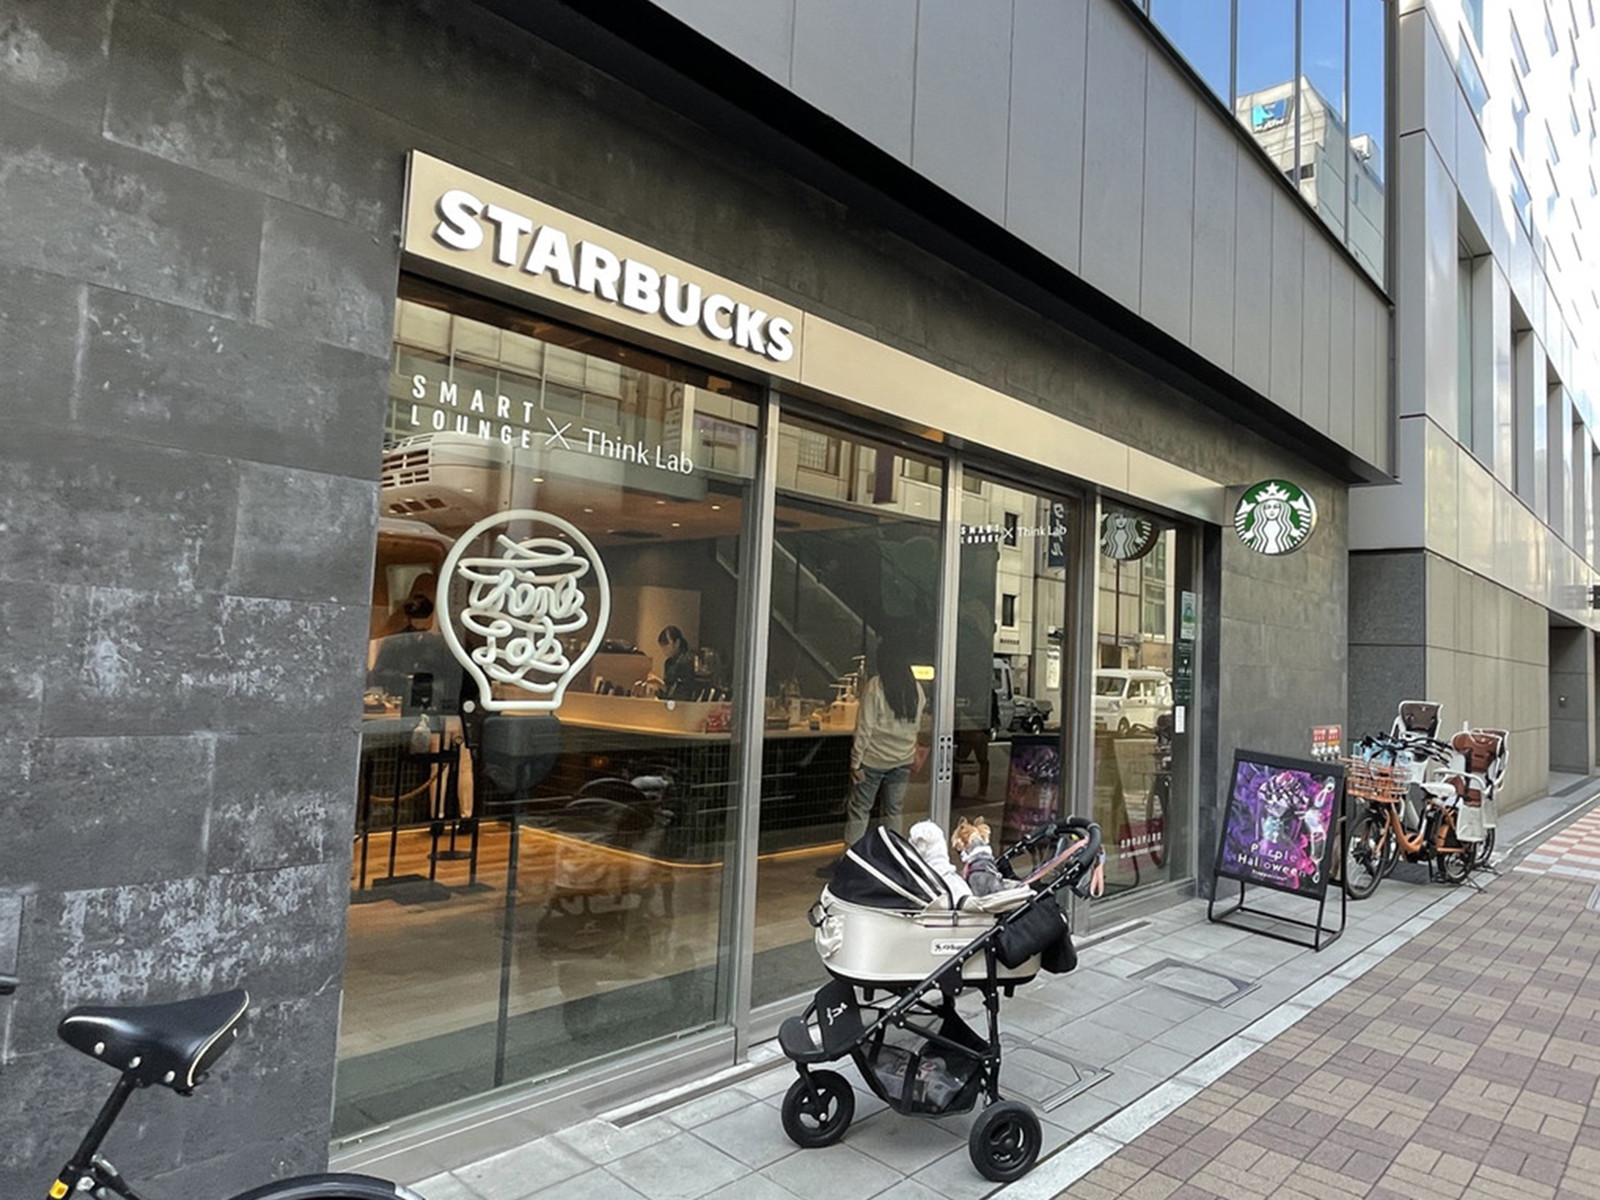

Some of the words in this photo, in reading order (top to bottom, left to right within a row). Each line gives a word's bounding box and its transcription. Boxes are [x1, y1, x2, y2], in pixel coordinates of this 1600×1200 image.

[433, 188, 794, 363] STARBUCKS
[411, 373, 534, 424] SMART
[410, 404, 532, 450] LOUNGE
[582, 426, 650, 466] Think
[655, 443, 694, 475] Lab
[1016, 525, 1046, 537] Think
[1047, 524, 1068, 537] Lab
